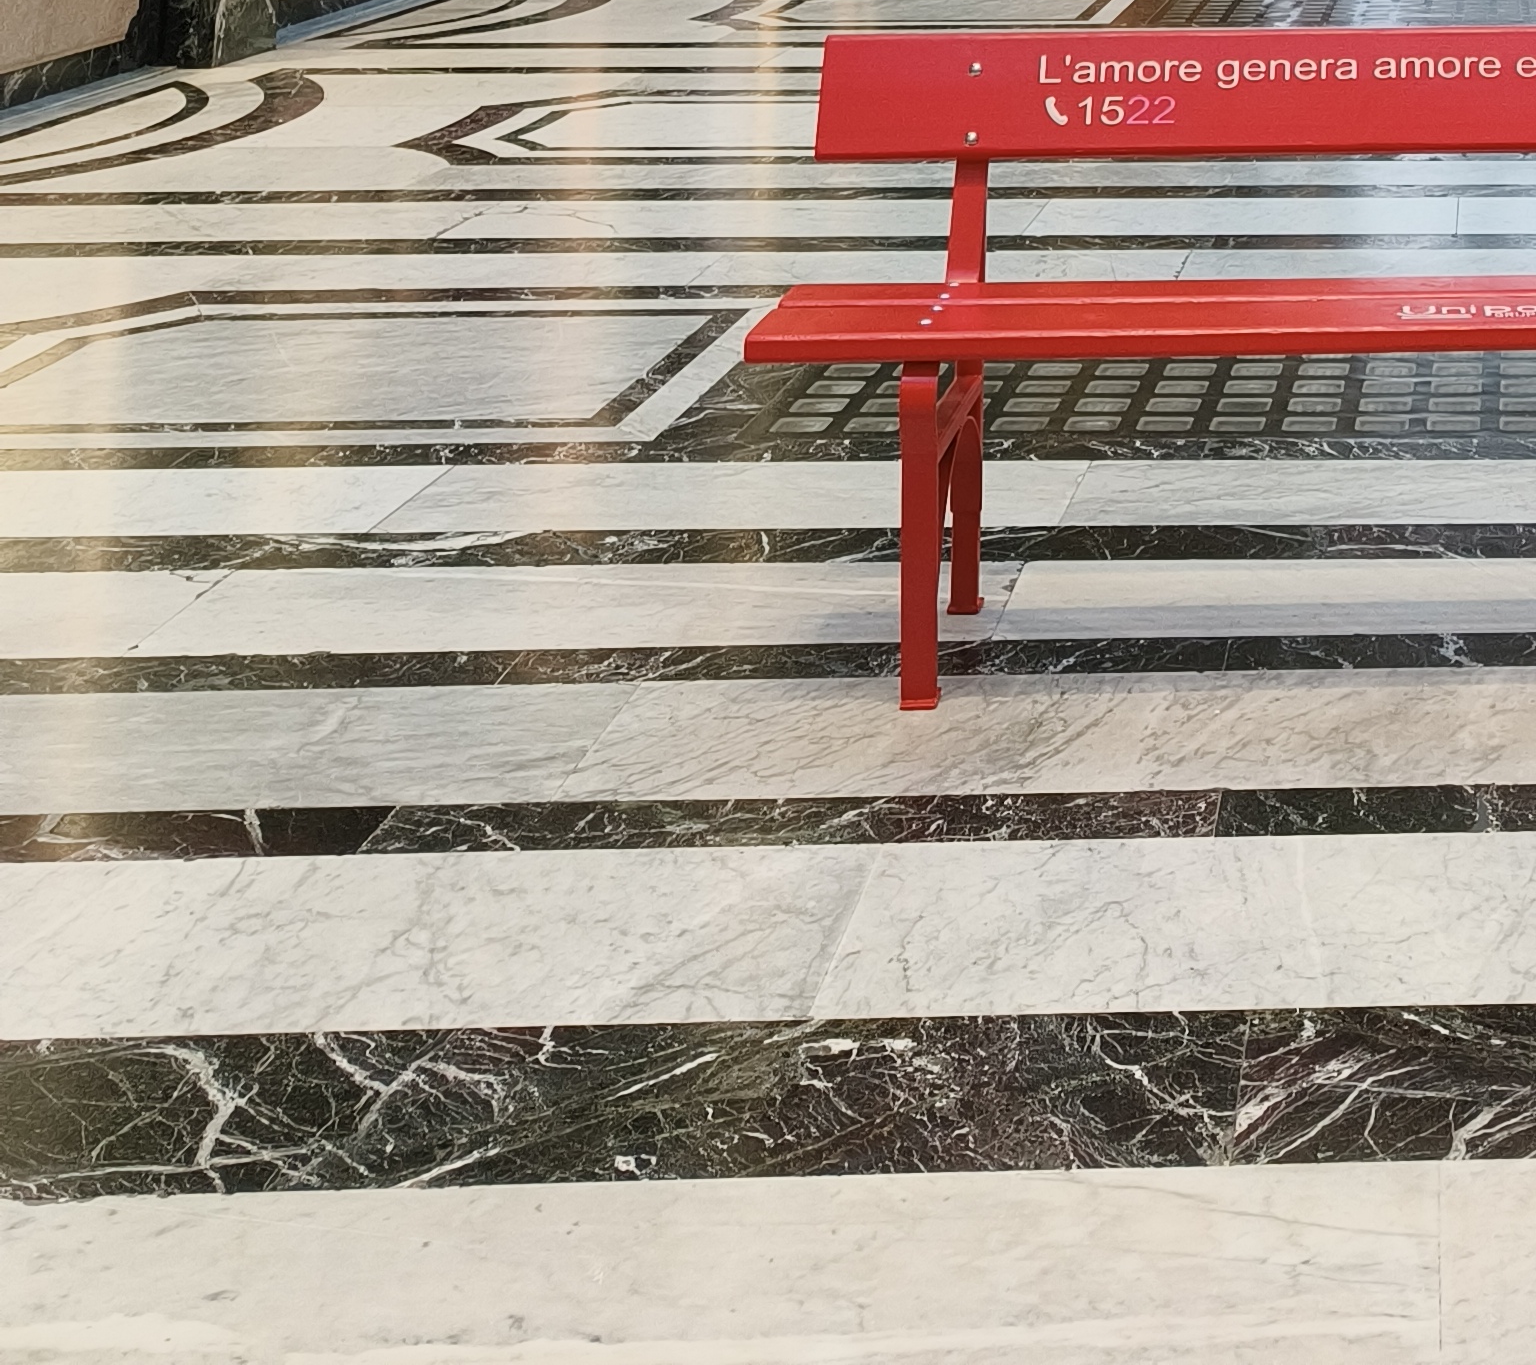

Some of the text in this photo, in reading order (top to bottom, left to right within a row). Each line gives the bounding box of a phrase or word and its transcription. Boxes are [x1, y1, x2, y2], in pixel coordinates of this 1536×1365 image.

[1038, 53, 1203, 85] L'amore
[1216, 56, 1359, 90] genera
[1373, 54, 1502, 80] amore
[1077, 95, 1177, 126] 1522
